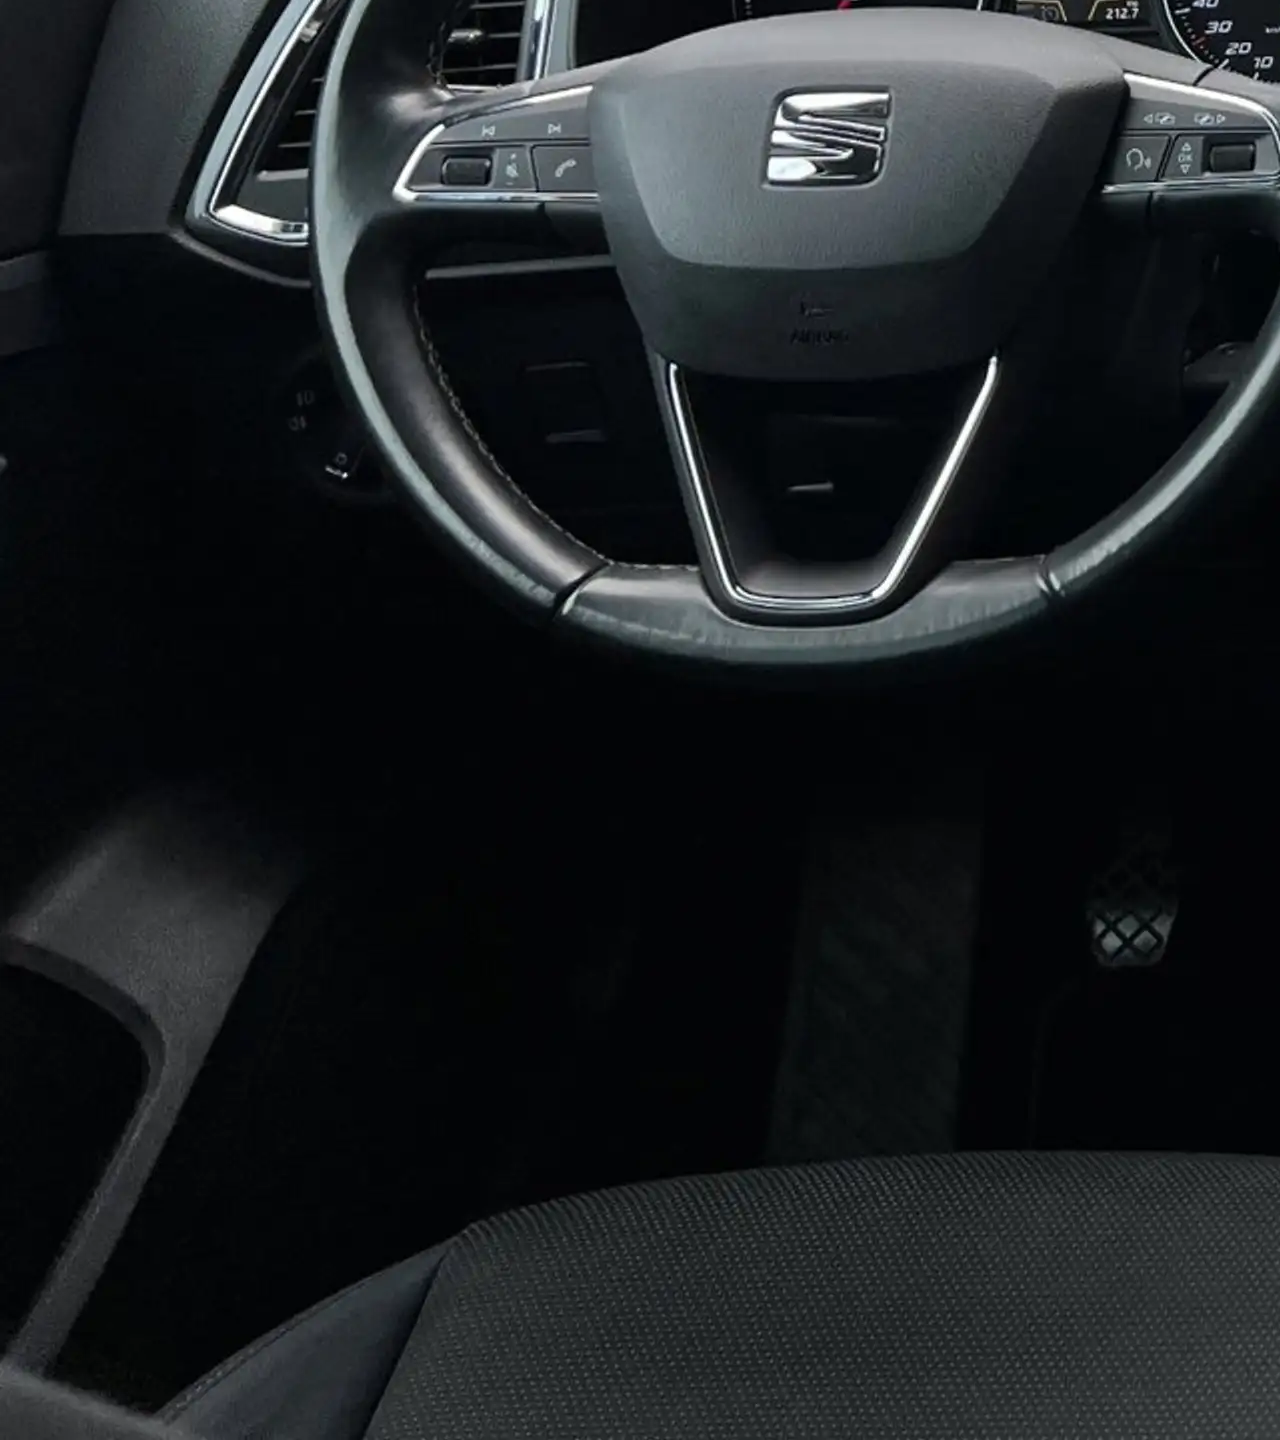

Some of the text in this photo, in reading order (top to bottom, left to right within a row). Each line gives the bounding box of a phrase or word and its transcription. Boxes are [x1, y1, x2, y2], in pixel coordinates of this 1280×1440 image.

[1105, 8, 1139, 20] 212.7
[1204, 20, 1233, 34] 30
[1224, 41, 1252, 55] 20
[1254, 56, 1274, 69] 10
